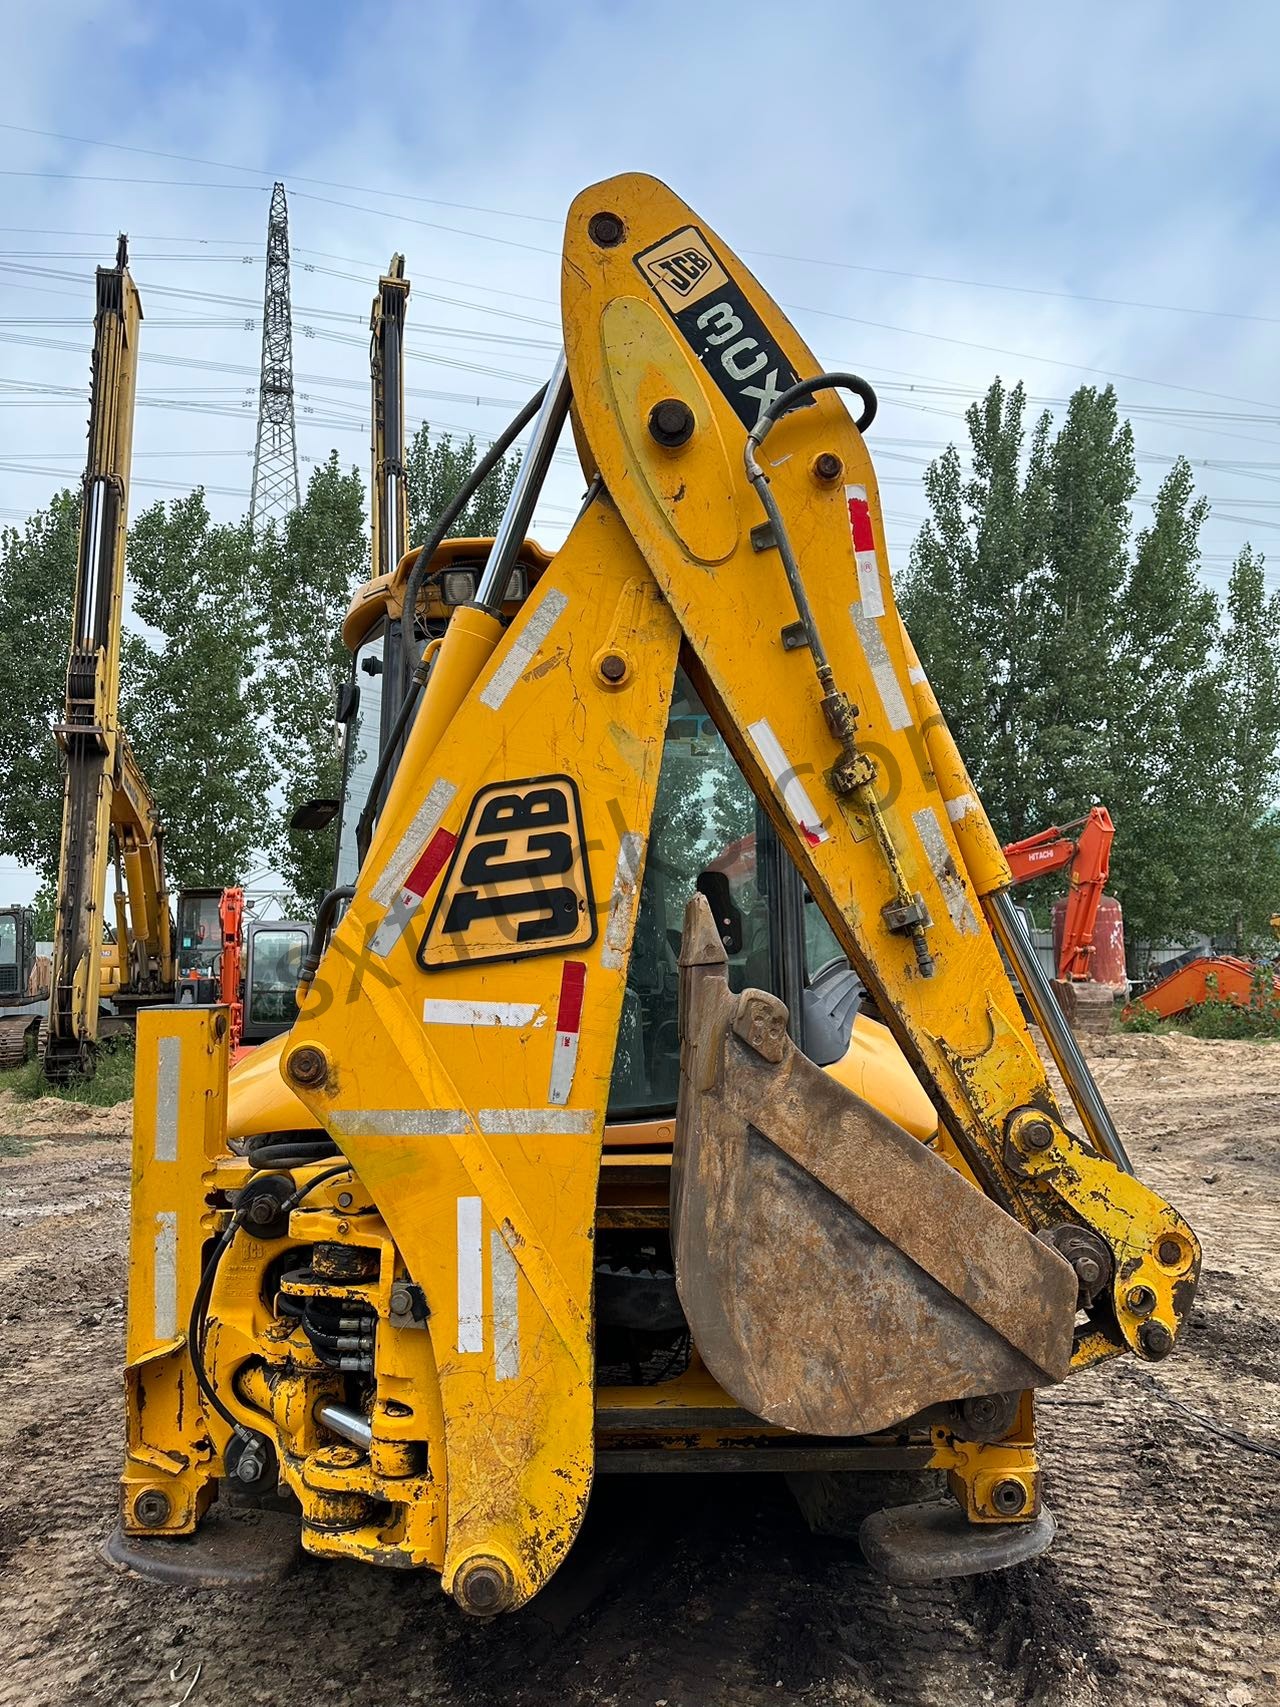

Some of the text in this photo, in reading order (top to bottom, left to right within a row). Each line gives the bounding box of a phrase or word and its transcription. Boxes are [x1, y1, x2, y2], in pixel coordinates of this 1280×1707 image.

[659, 251, 708, 290] JCB
[697, 302, 786, 427] 3CX
[442, 788, 579, 942] JCB
[1028, 850, 1054, 861] HITACHI
[564, 1036, 571, 1047] 3M
